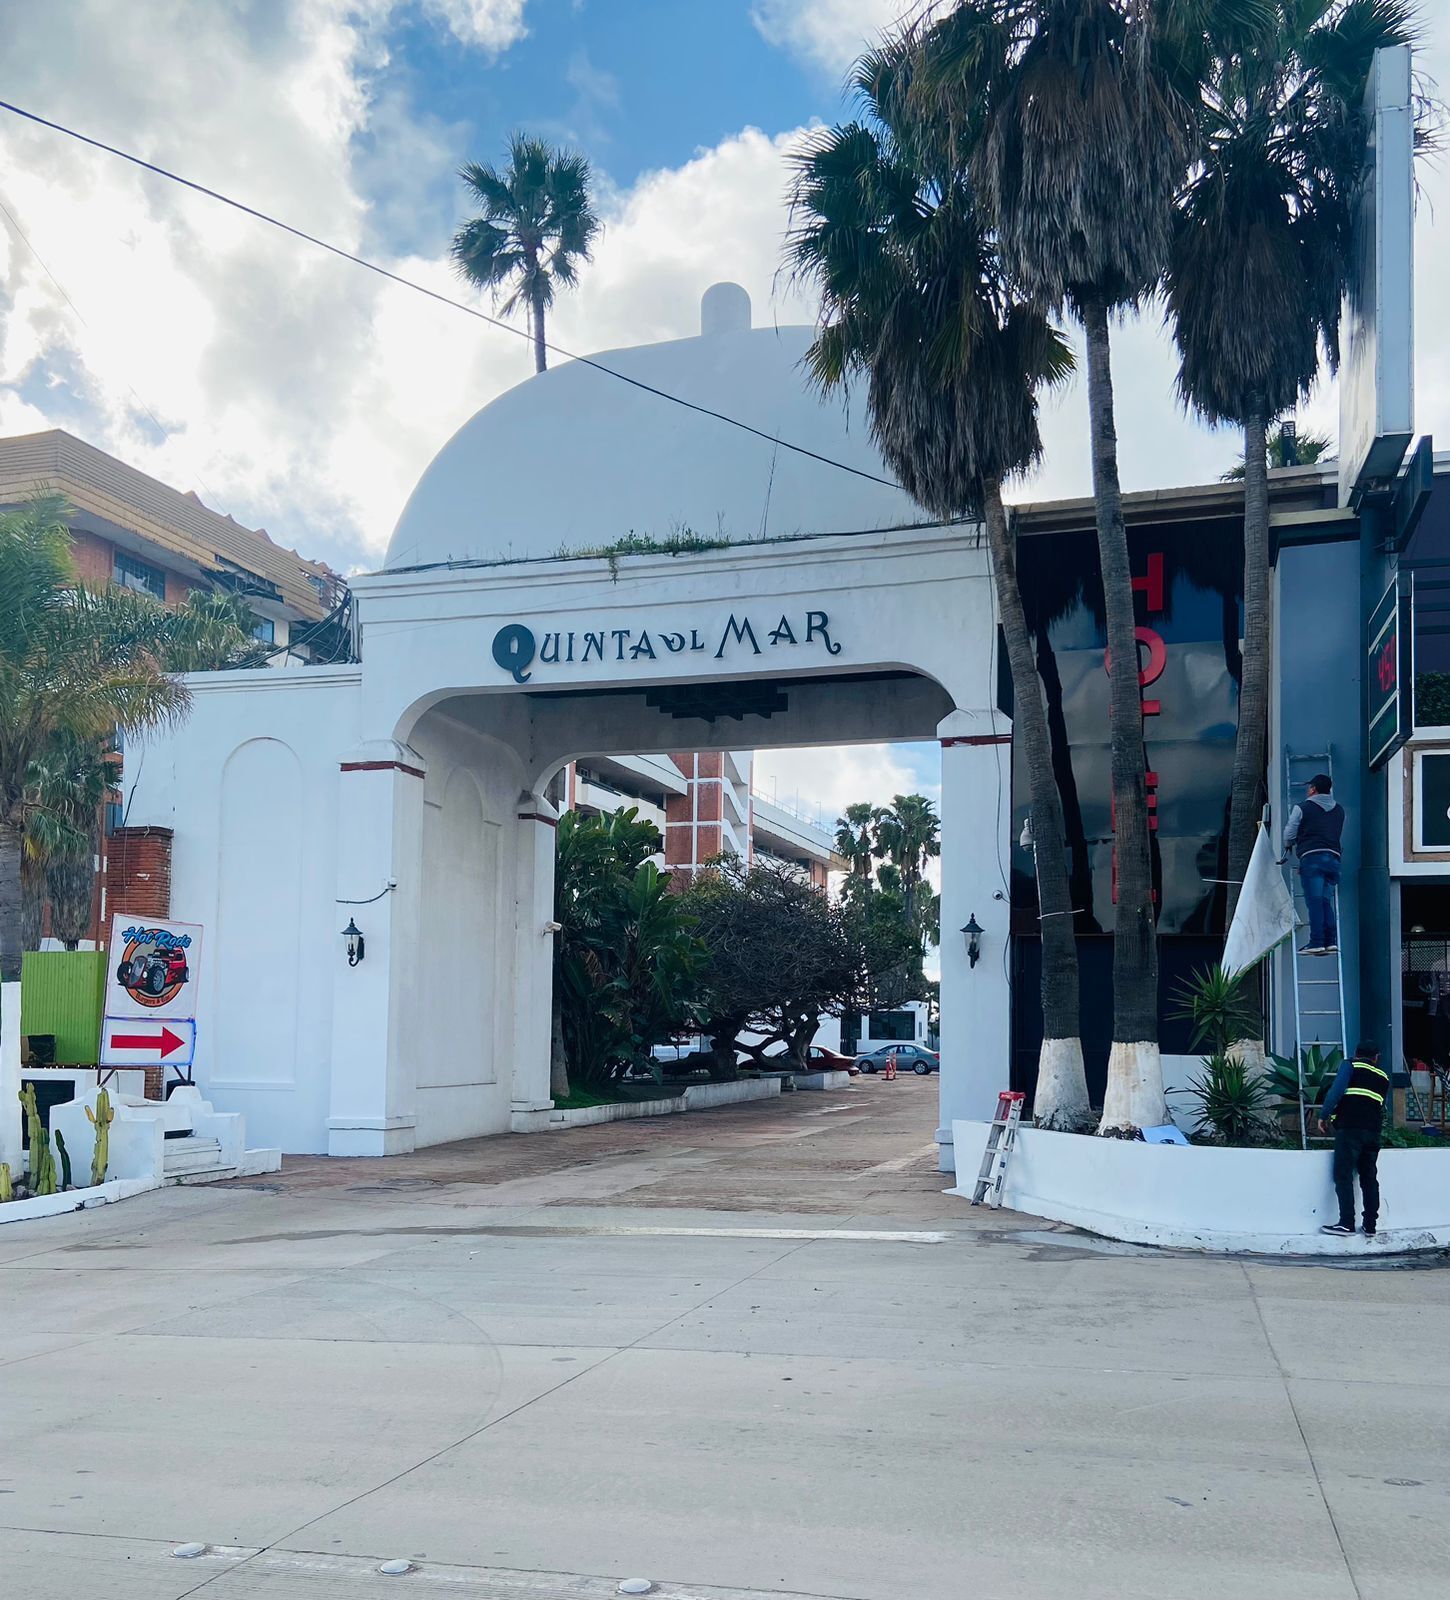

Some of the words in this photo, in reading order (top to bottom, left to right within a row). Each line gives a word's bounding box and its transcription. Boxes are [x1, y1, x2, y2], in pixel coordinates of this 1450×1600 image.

[492, 623, 657, 683] QUINTA
[713, 610, 842, 658] MAR
[121, 926, 154, 944] Hot
[154, 931, 192, 951] Rods
